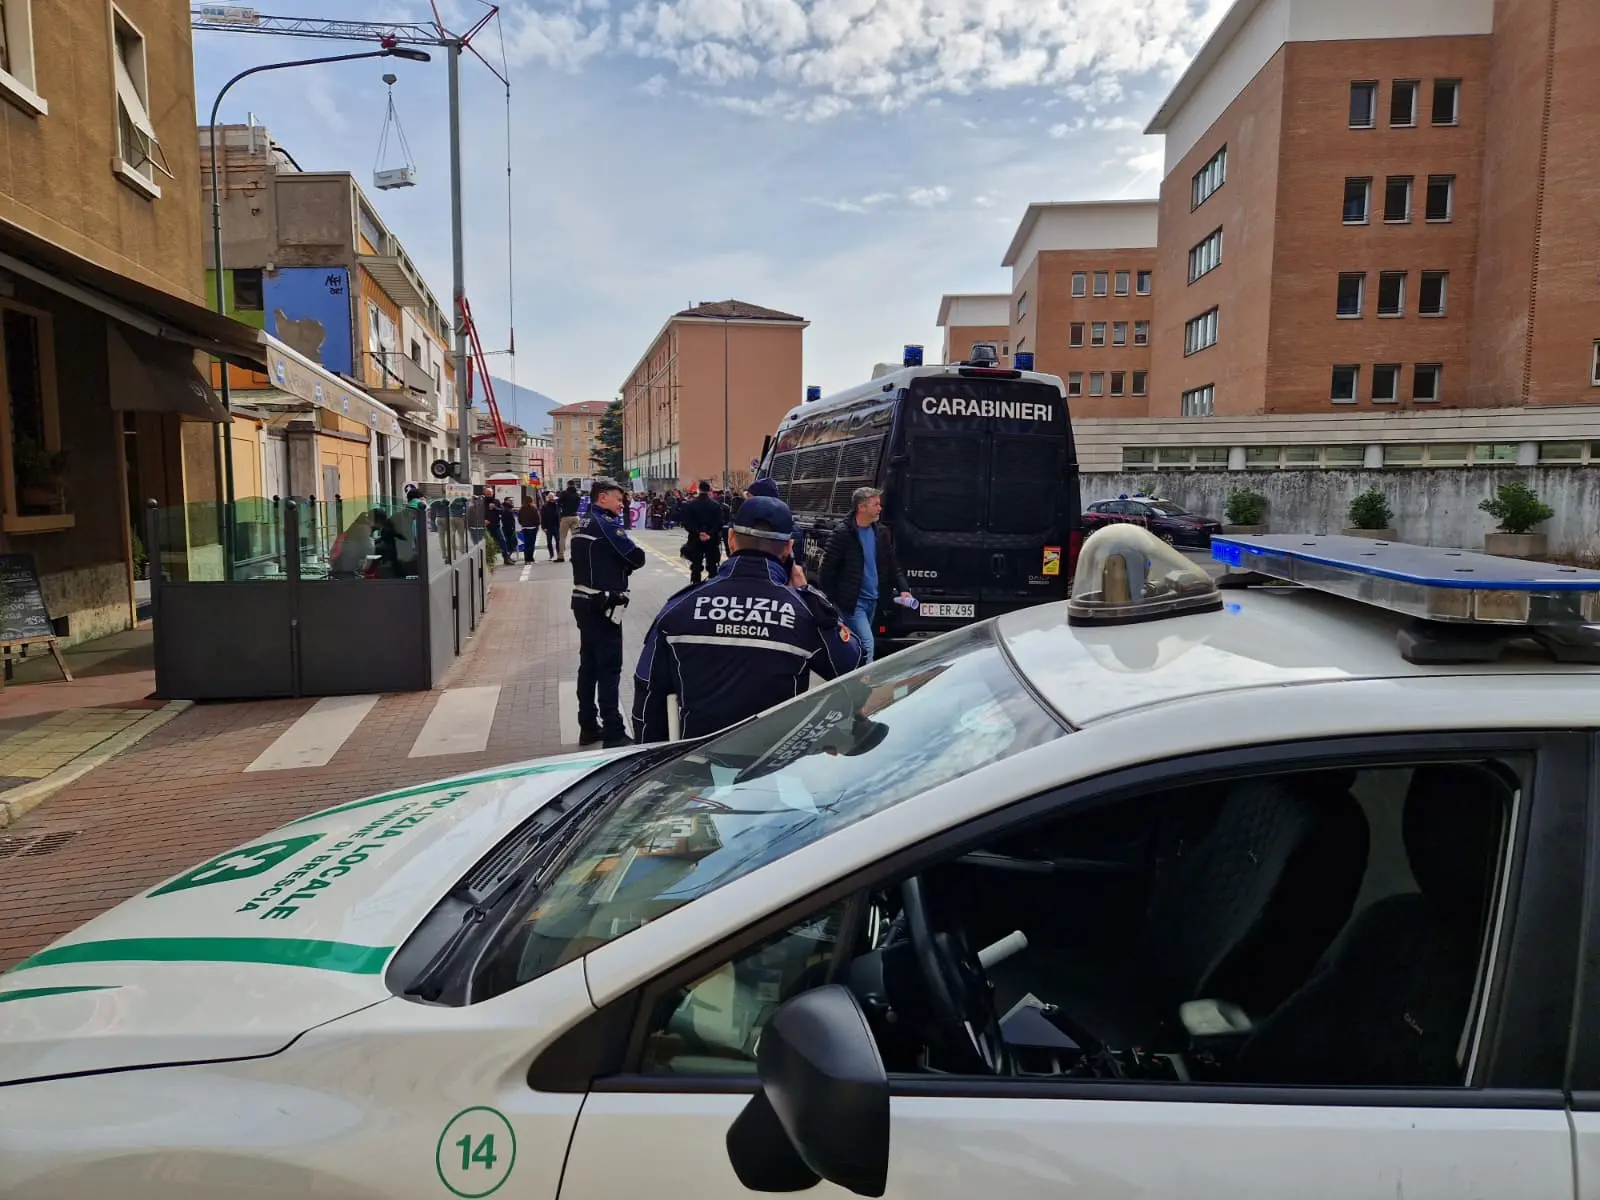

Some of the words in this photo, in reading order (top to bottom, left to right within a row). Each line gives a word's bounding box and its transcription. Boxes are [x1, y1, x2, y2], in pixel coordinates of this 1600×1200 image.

[921, 396, 1052, 422] CARABINIERI
[906, 569, 938, 578] IVECO
[695, 596, 796, 616] POLIZIA
[955, 604, 973, 616] 495
[693, 608, 796, 629] LOCALE
[715, 623, 770, 637] BRESCIA
[348, 802, 419, 839] COMUNE
[373, 790, 470, 839] POLIZIA
[327, 841, 354, 852] DI
[235, 854, 333, 913] BRESCIA
[259, 843, 386, 920] LOCALE
[455, 1134, 497, 1170] 14
